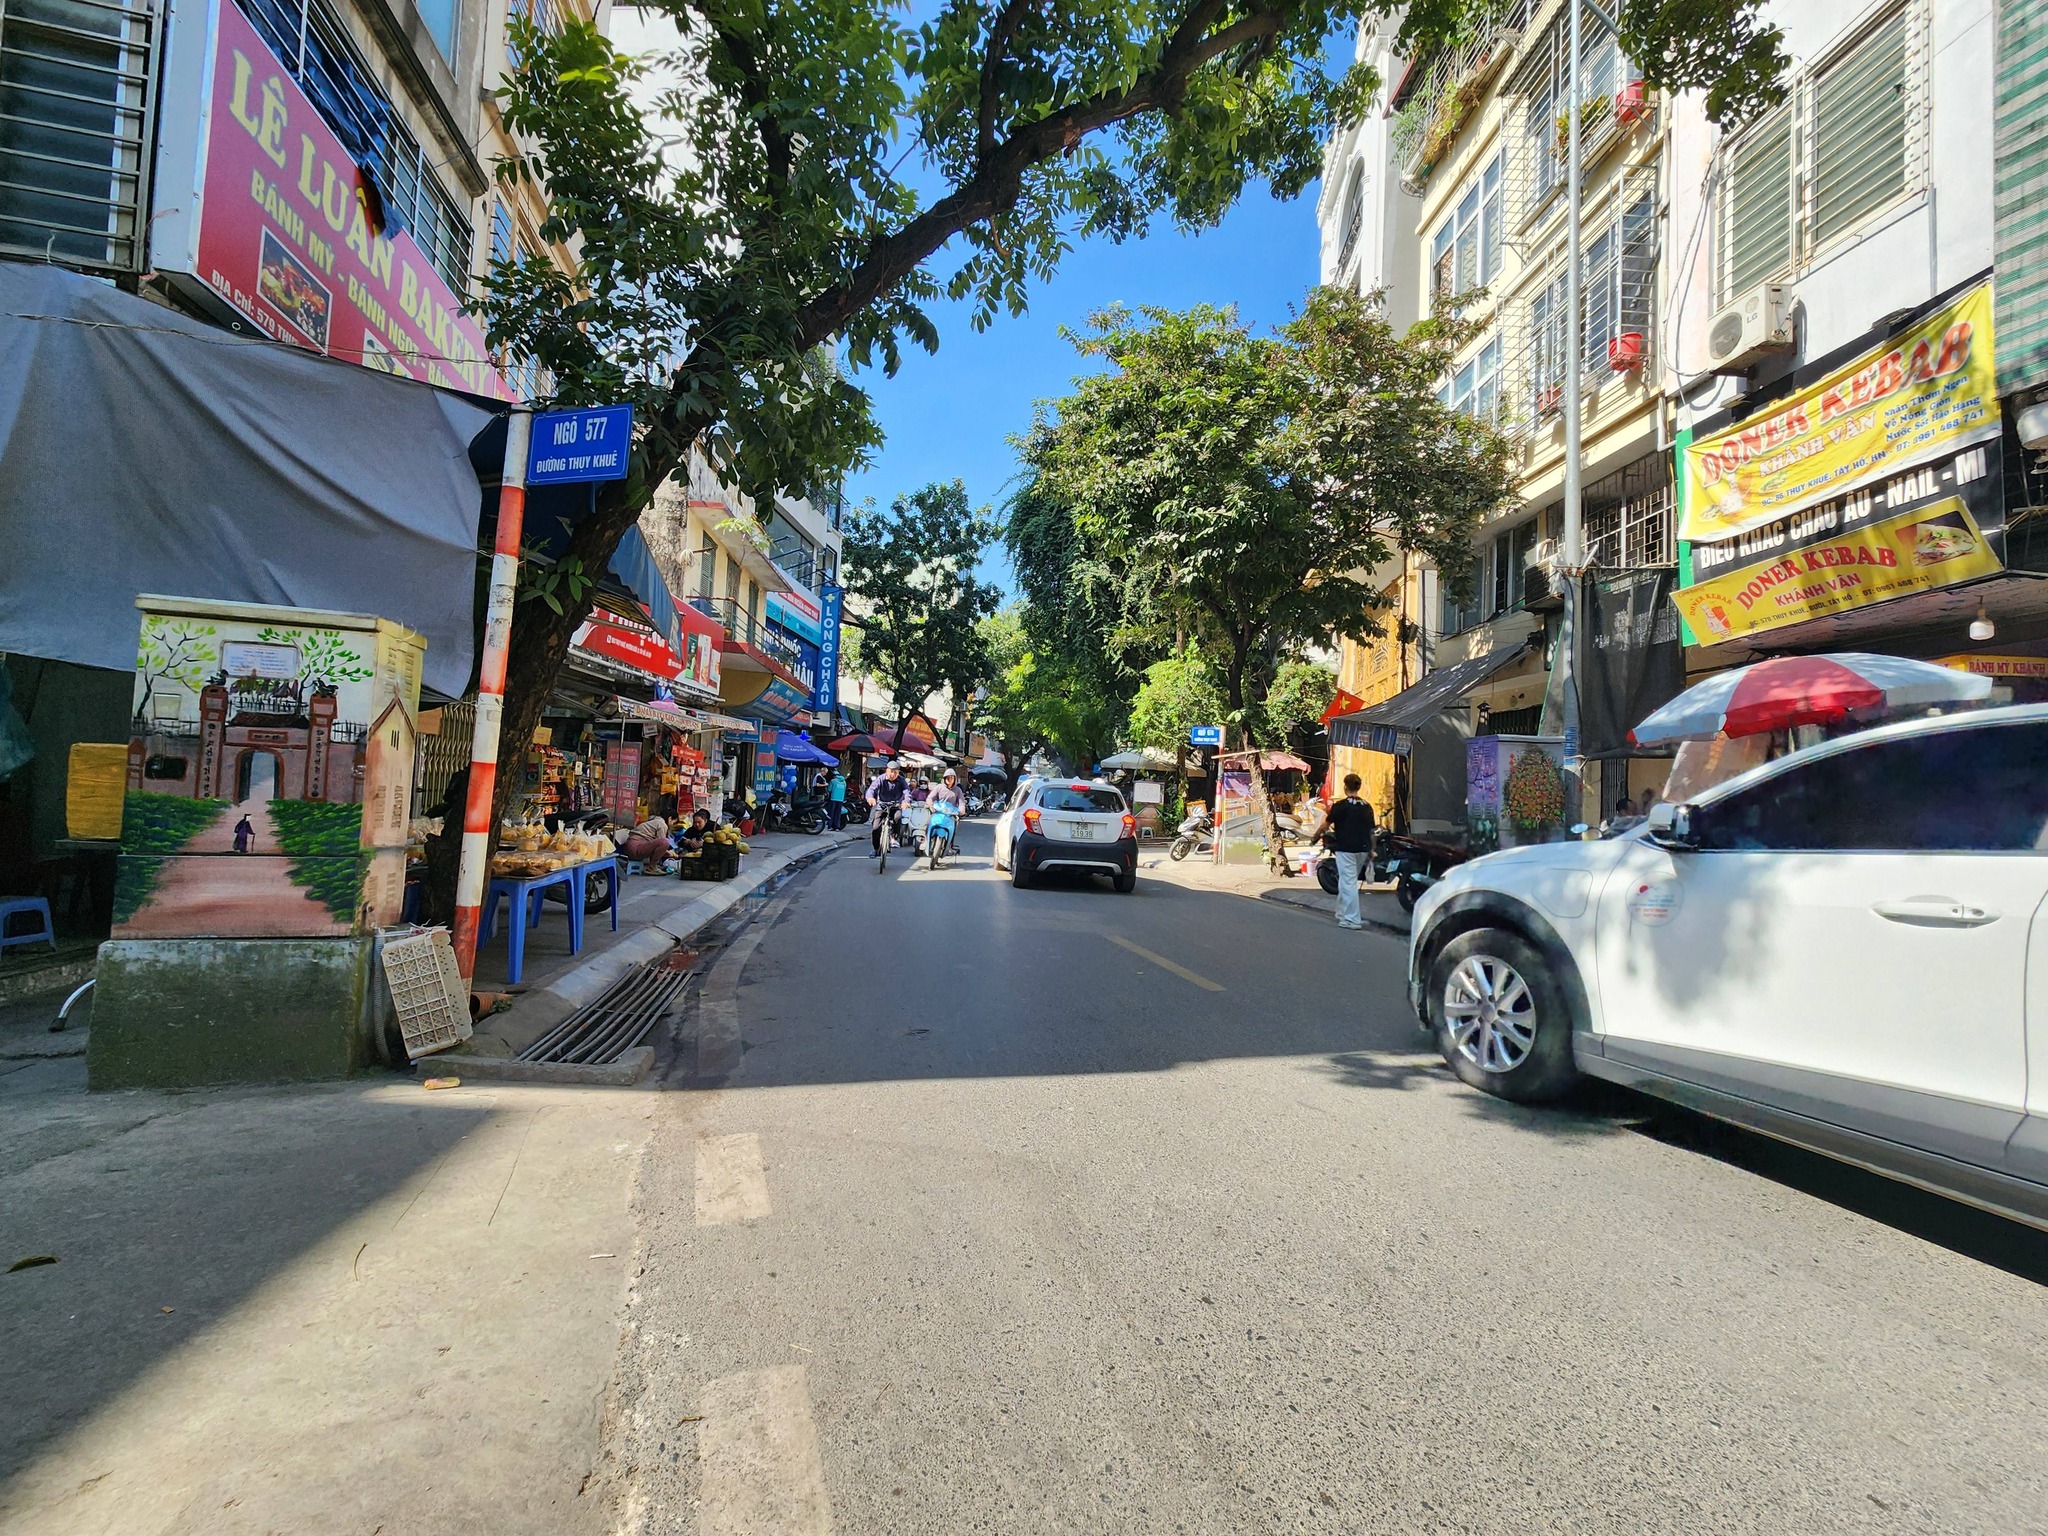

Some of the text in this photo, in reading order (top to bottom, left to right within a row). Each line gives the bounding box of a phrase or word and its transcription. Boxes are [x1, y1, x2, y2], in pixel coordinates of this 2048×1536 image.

[229, 48, 288, 169] LÊ
[399, 260, 490, 396] BAKERY
[251, 169, 305, 247] BÁNH
[308, 229, 335, 277] MỲ
[348, 274, 386, 333] BÁNH
[388, 317, 420, 367] NGỌT
[256, 308, 276, 332] 579
[1747, 312, 1758, 324] LG
[1700, 321, 1972, 487] DONER KEBAB
[1910, 390, 1940, 406] Thơm
[554, 416, 608, 445] NGÕ 577
[1900, 408, 1927, 423] Nóng
[1759, 411, 1875, 477] KHÁNH VÂN
[1871, 451, 1887, 462] HN
[1963, 409, 1984, 423] 741
[536, 450, 618, 474] ĐƯỜNG THỤY KHUÊ
[1790, 501, 1837, 540] CHÂU
[1844, 488, 1871, 518] ÂU
[1887, 467, 1940, 508] NAIL
[1955, 447, 1988, 486] MI
[1736, 545, 1897, 611] DONER KEBAB
[1775, 573, 1862, 607] KHÁNH VÂN
[1914, 575, 1930, 583] 741
[1705, 593, 1733, 605] KEBAB
[820, 606, 834, 705] LONG CHÂU
[1968, 659, 1994, 673] BÁNH
[2012, 660, 2045, 674] KHÁNH
